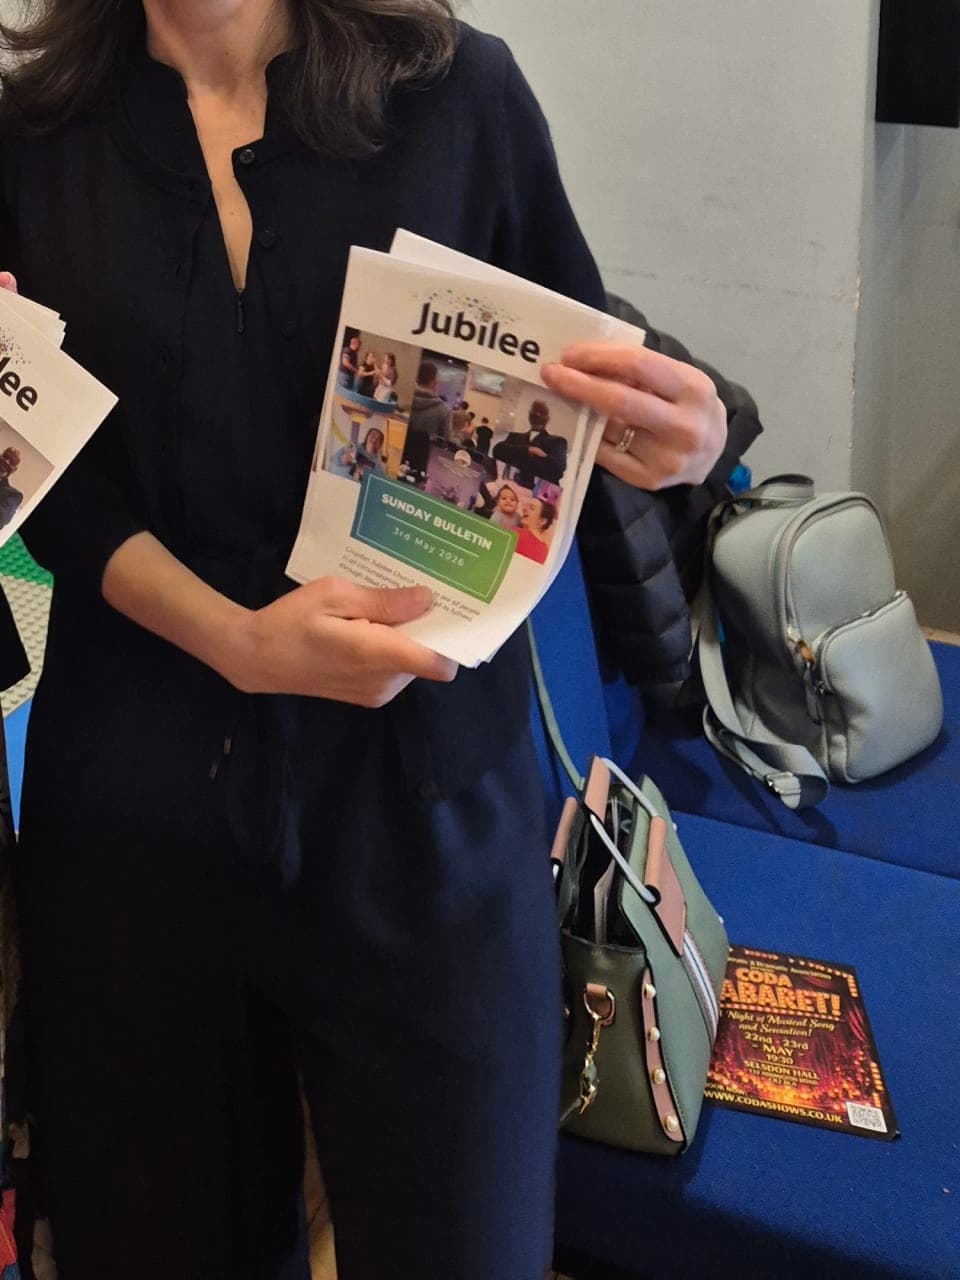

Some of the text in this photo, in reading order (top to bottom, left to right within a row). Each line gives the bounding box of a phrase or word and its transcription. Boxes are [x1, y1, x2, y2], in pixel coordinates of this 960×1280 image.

[411, 302, 540, 363] Jubilee
[381, 493, 493, 551] SUNDAY BULLETIN
[391, 526, 465, 568] 3rd May 2026
[735, 967, 792, 988] CODA
[720, 979, 841, 1017] ABARET!
[728, 1010, 754, 1023] Night
[765, 1014, 807, 1027] Musical
[739, 1023, 812, 1037] and Sensation!
[744, 1031, 772, 1044] 22nd
[782, 1039, 808, 1051] 23rd
[762, 1044, 794, 1057] MAY
[766, 1054, 794, 1065] 19:30
[744, 1060, 820, 1080] SELSDON HALL
[703, 1090, 843, 1123] WWW.CODASHOWS.CO.UK
